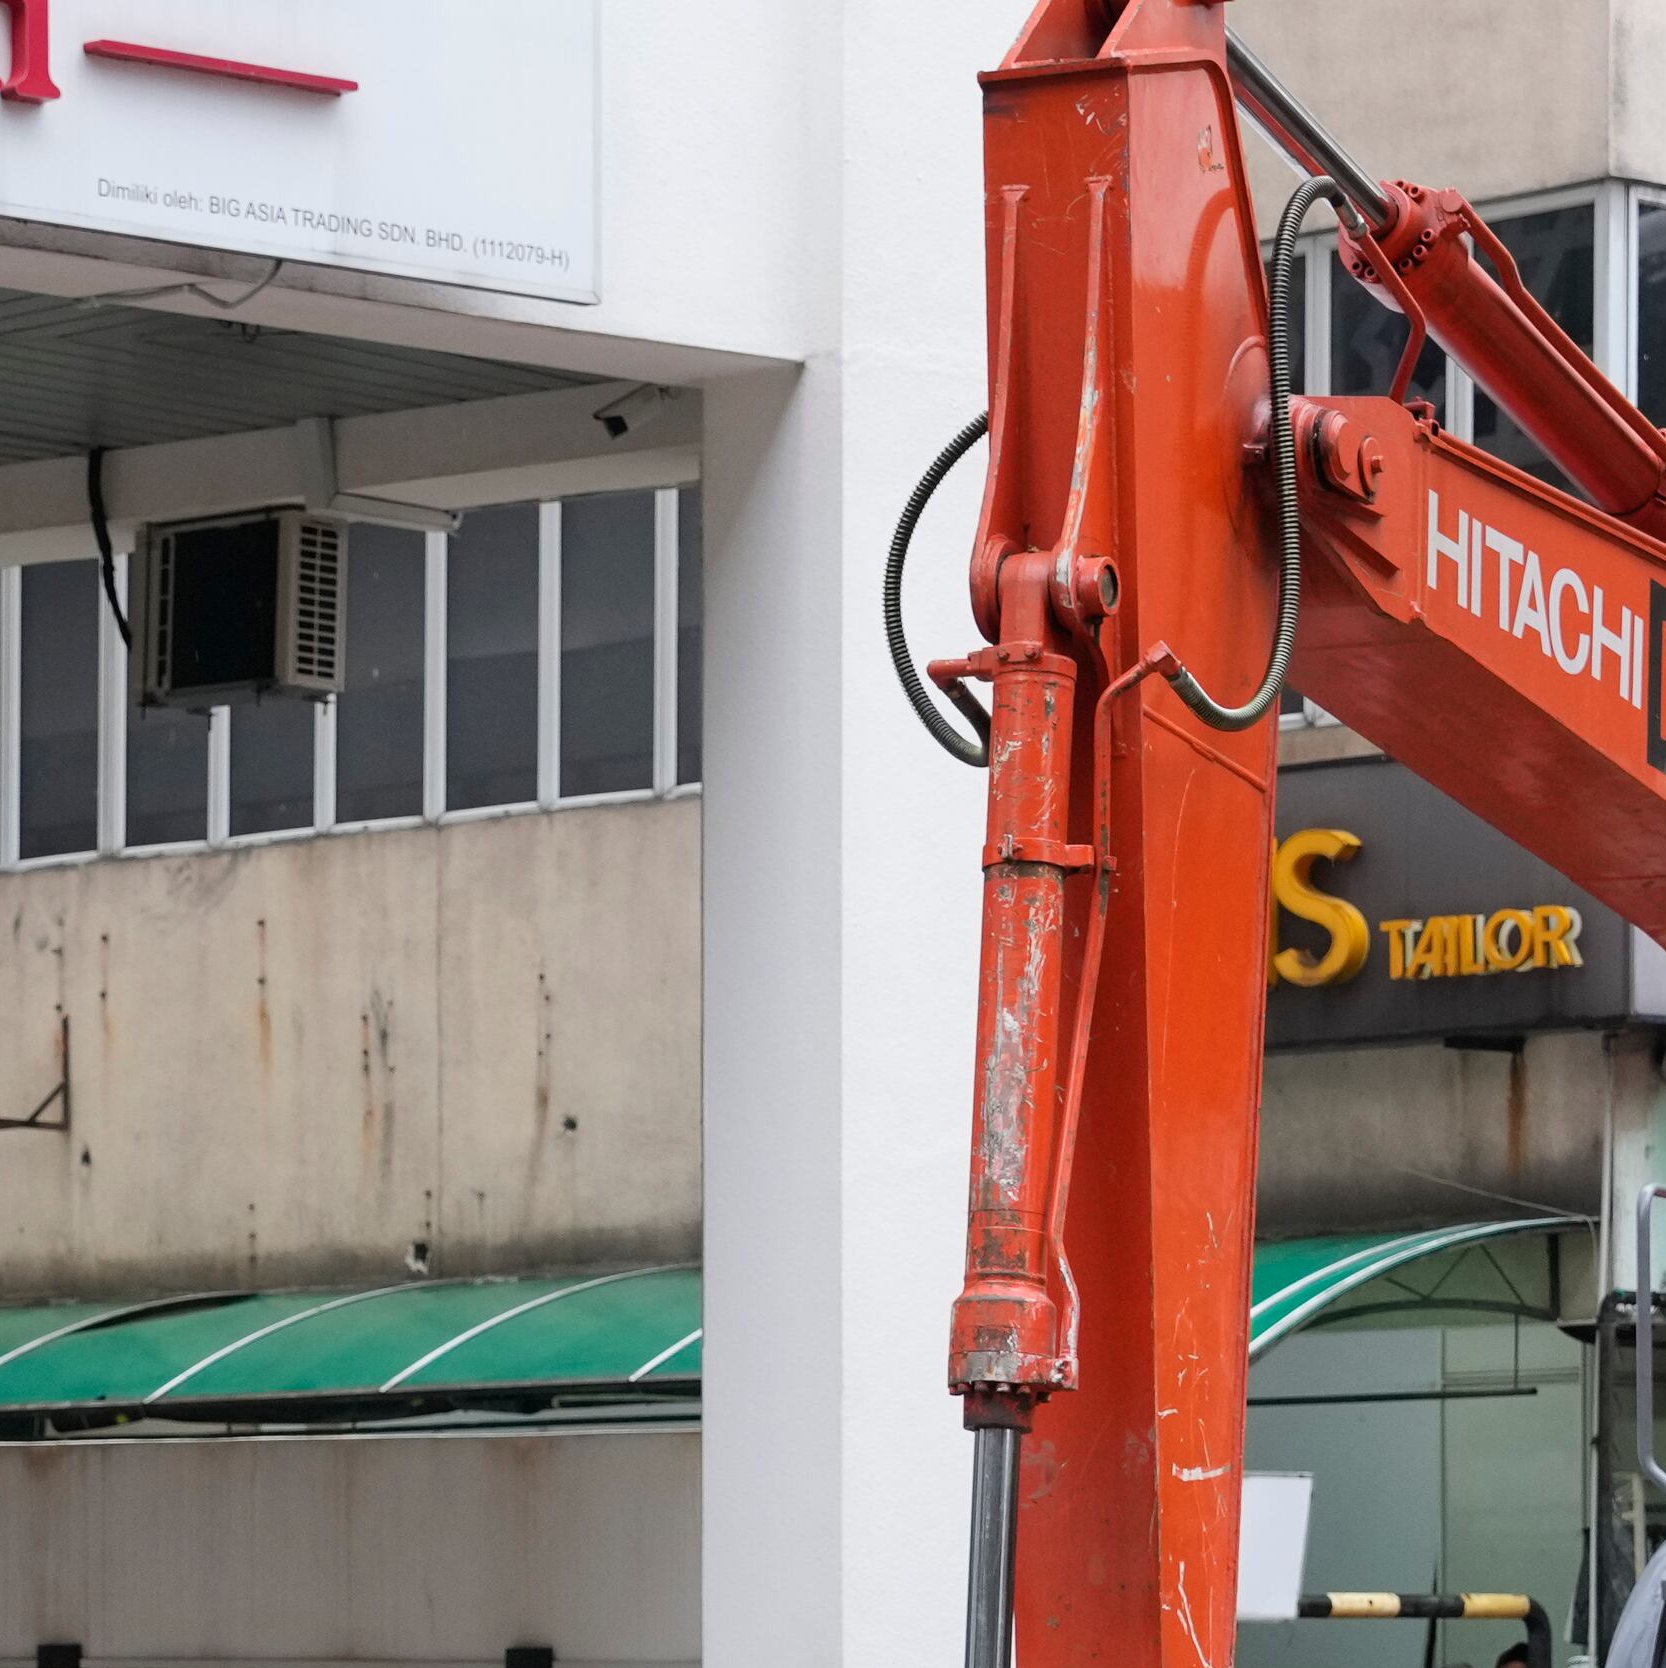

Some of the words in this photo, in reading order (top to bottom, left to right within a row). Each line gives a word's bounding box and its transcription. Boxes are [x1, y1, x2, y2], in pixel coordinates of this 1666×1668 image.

[97, 178, 159, 205] Dimiliki
[162, 188, 204, 212] oleh:
[208, 195, 241, 219] BIG
[244, 200, 288, 225] ASIA
[291, 206, 374, 238] TRADING
[378, 221, 422, 245] SDN.
[425, 228, 468, 254] BHD.
[1428, 489, 1644, 709] HITACHI
[1380, 904, 1585, 980] TAILOR
